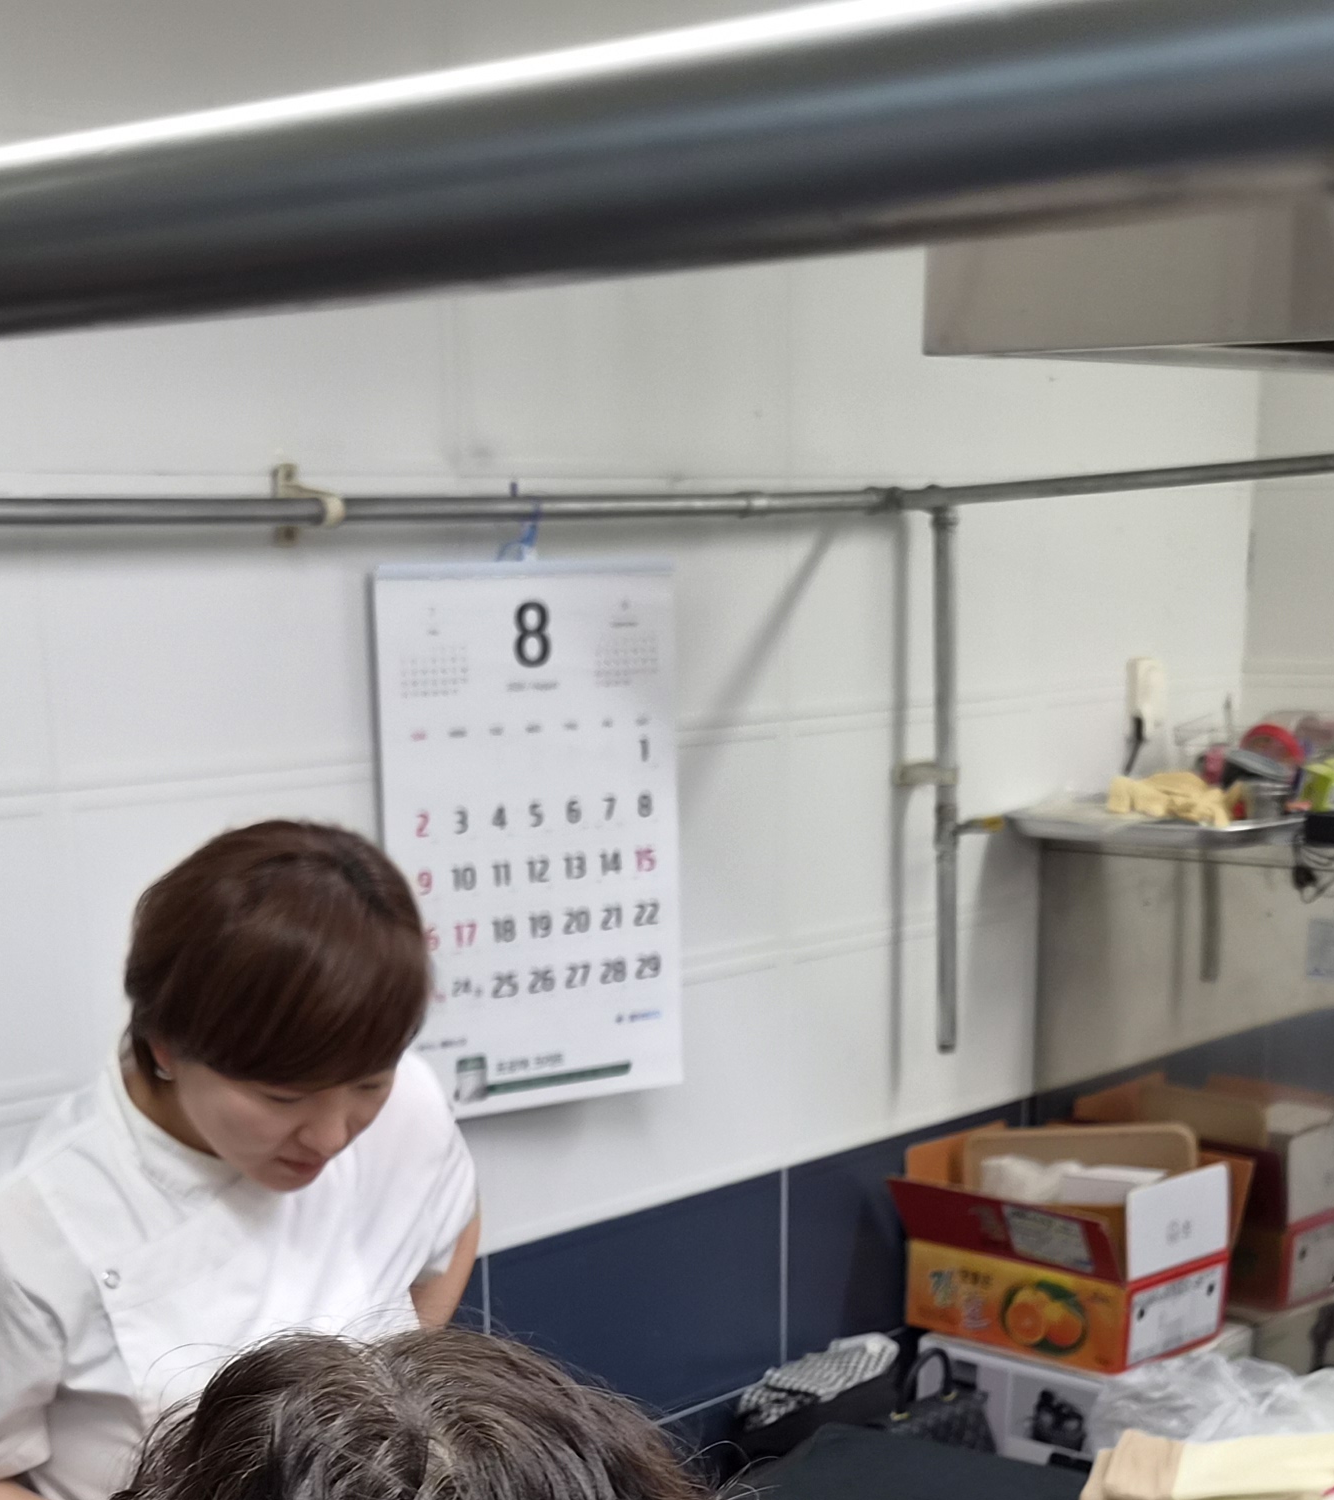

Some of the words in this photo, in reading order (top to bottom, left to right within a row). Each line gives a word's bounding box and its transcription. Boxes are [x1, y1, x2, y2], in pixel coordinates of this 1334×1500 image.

[513, 600, 552, 668] 8
[638, 738, 650, 763] 1
[415, 810, 430, 839] 2
[454, 806, 469, 835] 3
[491, 804, 508, 831] 4
[529, 801, 545, 828] 5
[566, 796, 583, 824] 6
[603, 795, 617, 822] 7
[637, 791, 653, 818] 8
[417, 870, 433, 897] 9
[451, 864, 477, 892] 10
[492, 861, 512, 889] 11
[527, 857, 551, 884] 12
[564, 854, 587, 881] 13
[599, 850, 623, 877] 14
[634, 846, 657, 874] 15
[454, 921, 478, 949] 17
[491, 916, 517, 944] 18
[528, 911, 553, 939] 19
[562, 907, 591, 936] 20
[599, 903, 623, 931] 21
[633, 901, 660, 928] 22
[490, 972, 519, 1000] 25
[528, 967, 556, 996] 26
[565, 962, 591, 990] 27
[599, 956, 627, 986] 28
[634, 951, 661, 981] 29
